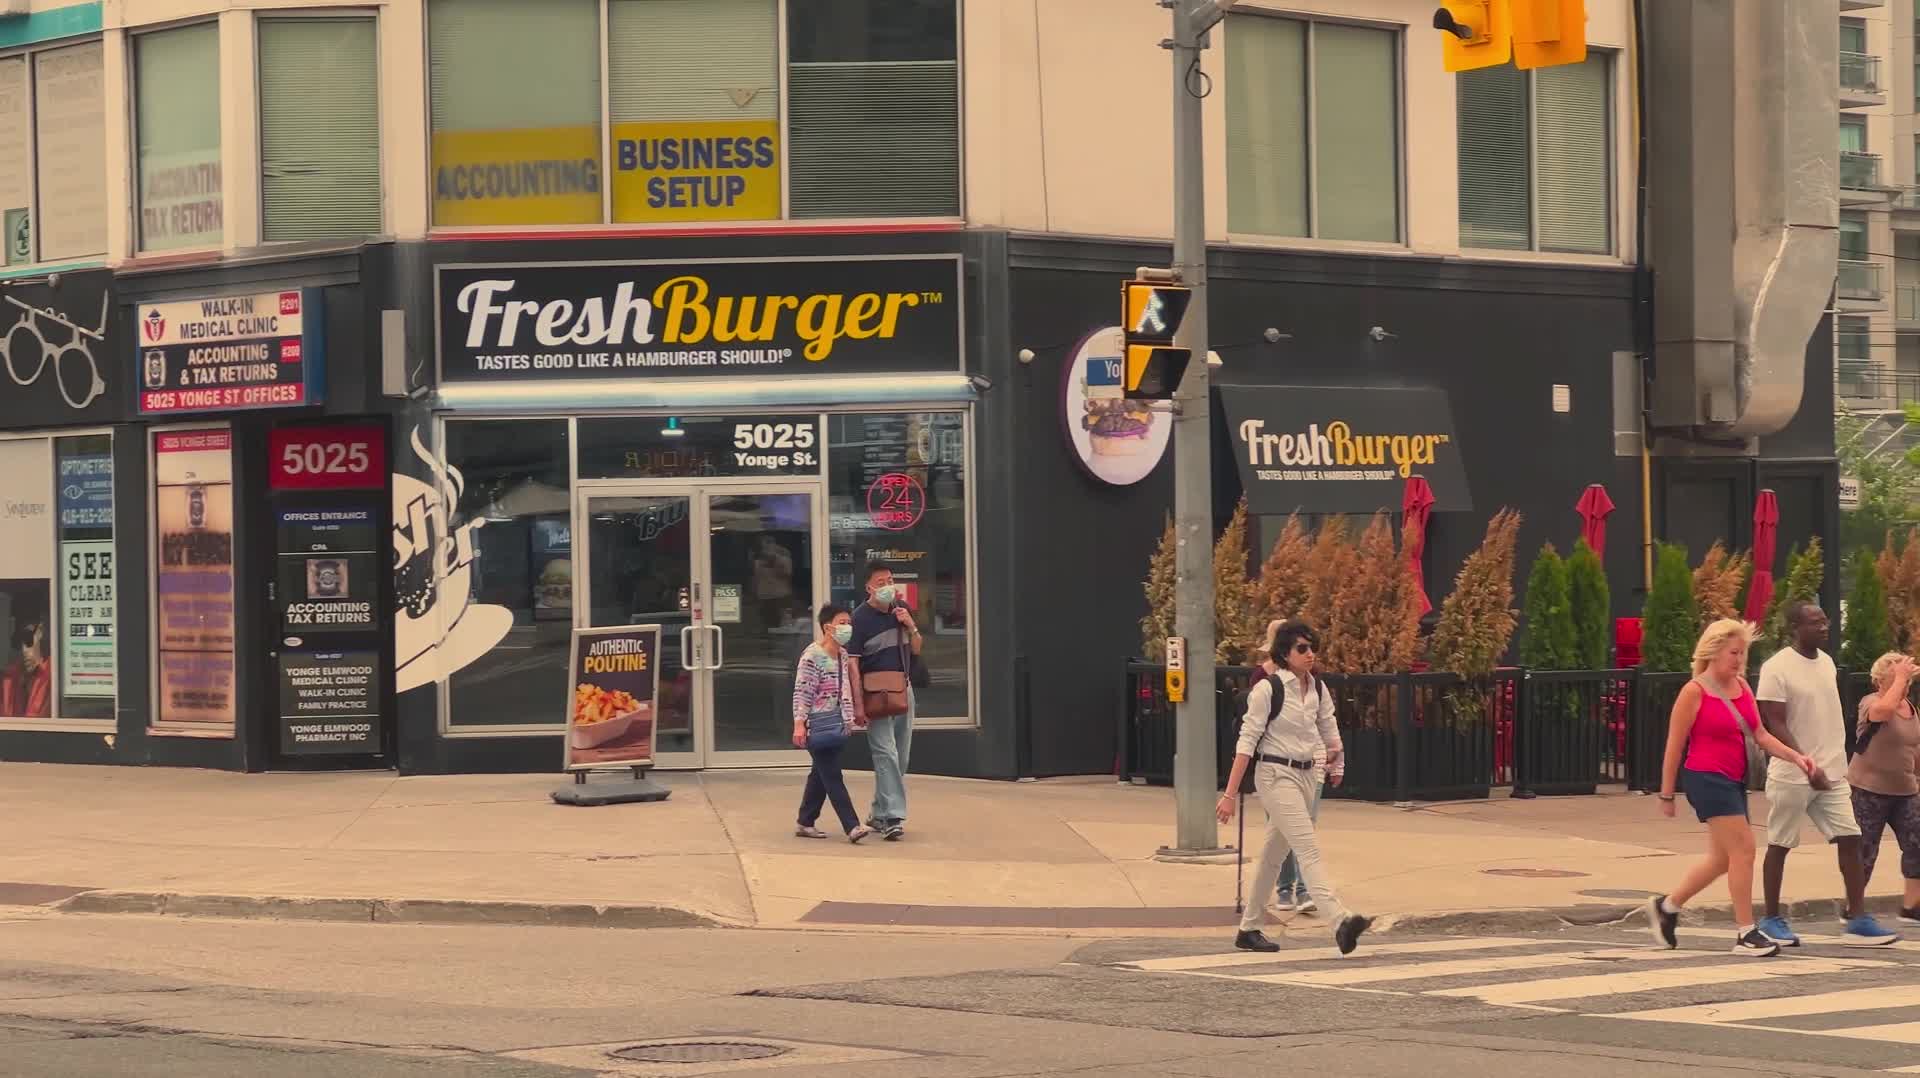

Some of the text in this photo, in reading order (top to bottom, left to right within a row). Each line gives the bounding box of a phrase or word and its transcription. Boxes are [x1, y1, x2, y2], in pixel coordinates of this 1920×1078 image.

[617, 136, 774, 171] BUSINESS
[437, 159, 598, 199] ACCOUNTING
[647, 176, 745, 208] SETUP
[201, 298, 254, 317] WALK-IN
[180, 316, 278, 339] MEDICAL CLINIC
[187, 344, 269, 365] ACCOUNTING
[475, 355, 530, 370] TASTES
[533, 354, 574, 369] GOOD
[577, 353, 609, 368] LIKE
[612, 353, 624, 368] A
[626, 350, 717, 367] HAMBURGER
[180, 363, 278, 385] & TAX RETURNS
[147, 385, 296, 409] 5025 YONGE ST OFFICES
[733, 423, 815, 449] 5025
[282, 442, 369, 474] 5025
[734, 452, 790, 470] Yonge
[792, 452, 818, 466] St.
[881, 476, 911, 487] OPEN
[880, 486, 914, 511] 24
[283, 511, 368, 521] OFFICES ENTRANCE
[69, 552, 112, 580] SEE
[69, 585, 112, 601] CLEAR
[715, 588, 736, 597] PASS
[287, 602, 370, 613] ACCOUNTING
[287, 612, 371, 624] TAX RETURNS
[589, 639, 643, 656] AUTHENTIC
[286, 666, 372, 676] YONGE ELMWOOD
[584, 654, 647, 674] POUTINE
[292, 676, 368, 686] MEDICAL CLINIC
[298, 688, 367, 697] WALK-IN CLINIC
[298, 701, 367, 710] FAMILY PRACTICE
[290, 724, 371, 733] YONGE ELMWOOD
[296, 733, 366, 742] PHARMACY INC
